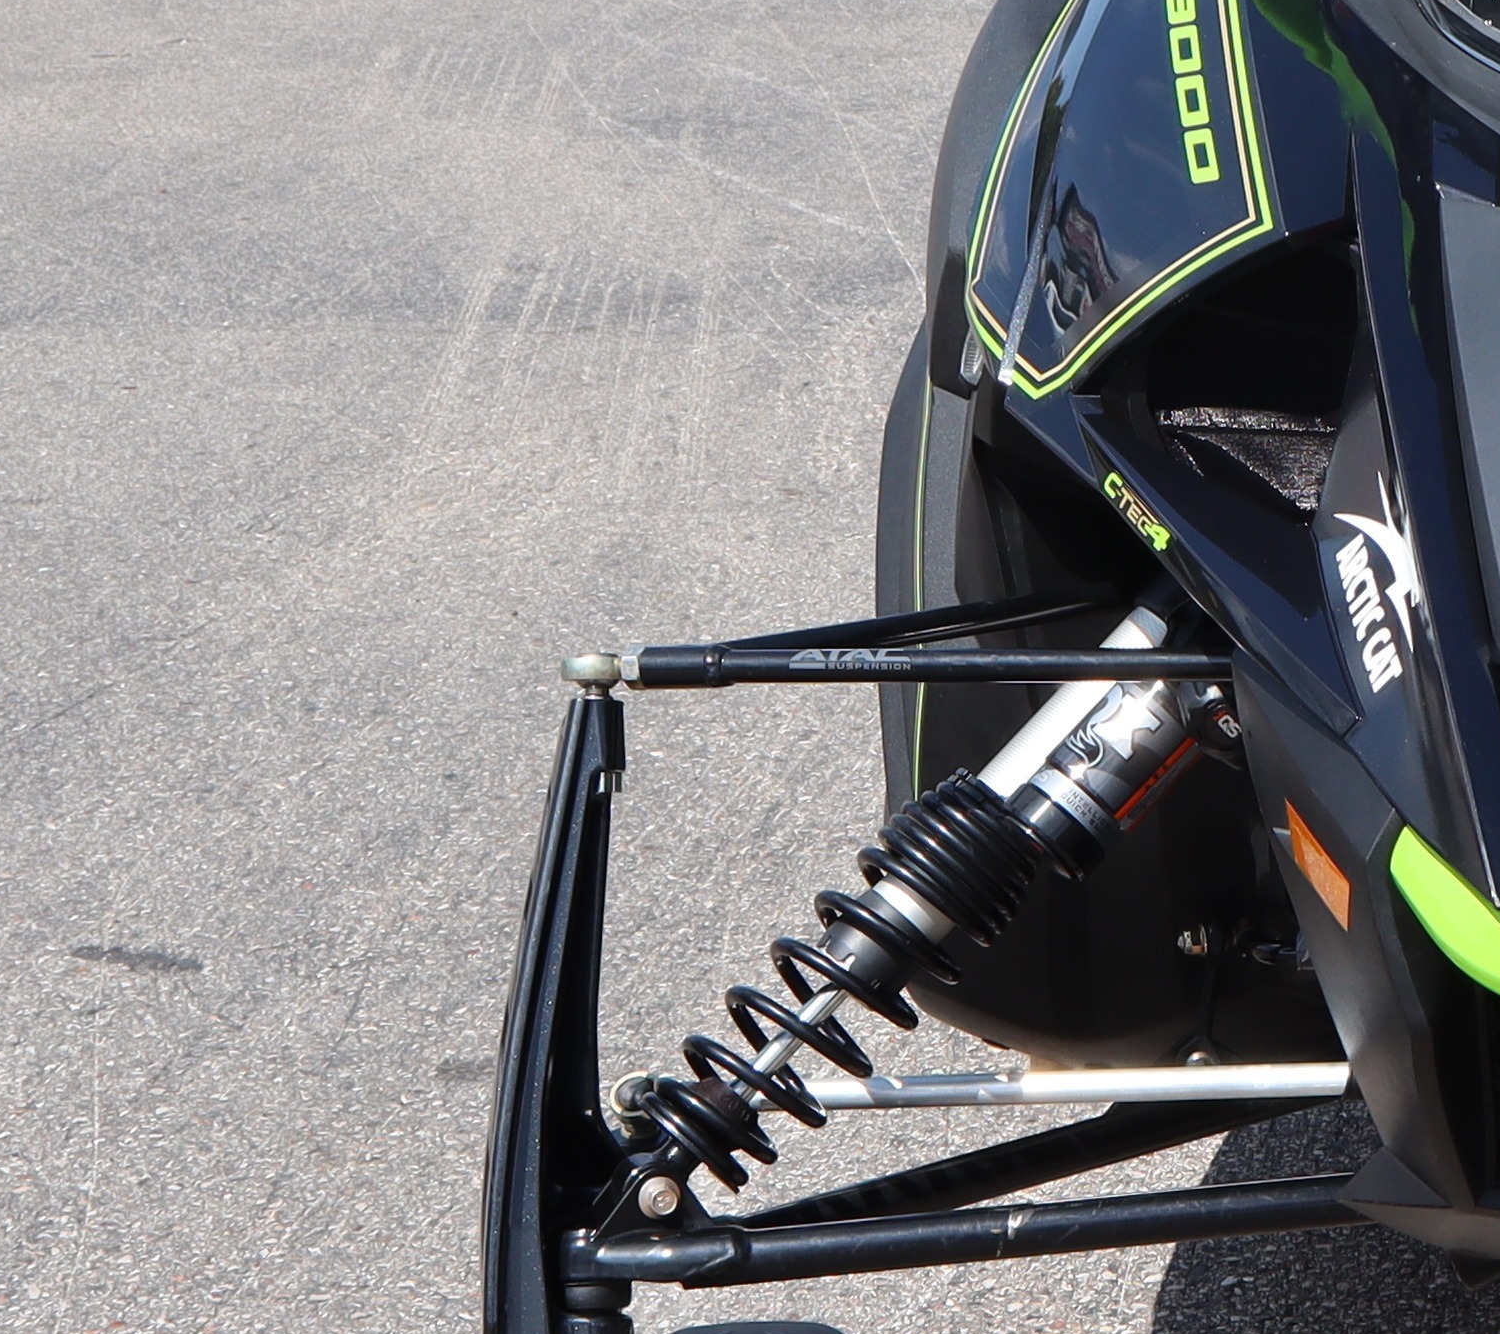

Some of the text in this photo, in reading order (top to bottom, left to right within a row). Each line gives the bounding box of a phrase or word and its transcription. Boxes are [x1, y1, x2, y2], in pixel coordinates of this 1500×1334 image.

[1335, 533, 1403, 694] ARCTIC CAT
[789, 648, 912, 662] ATAC
[826, 662, 912, 671] SUSPENSION
